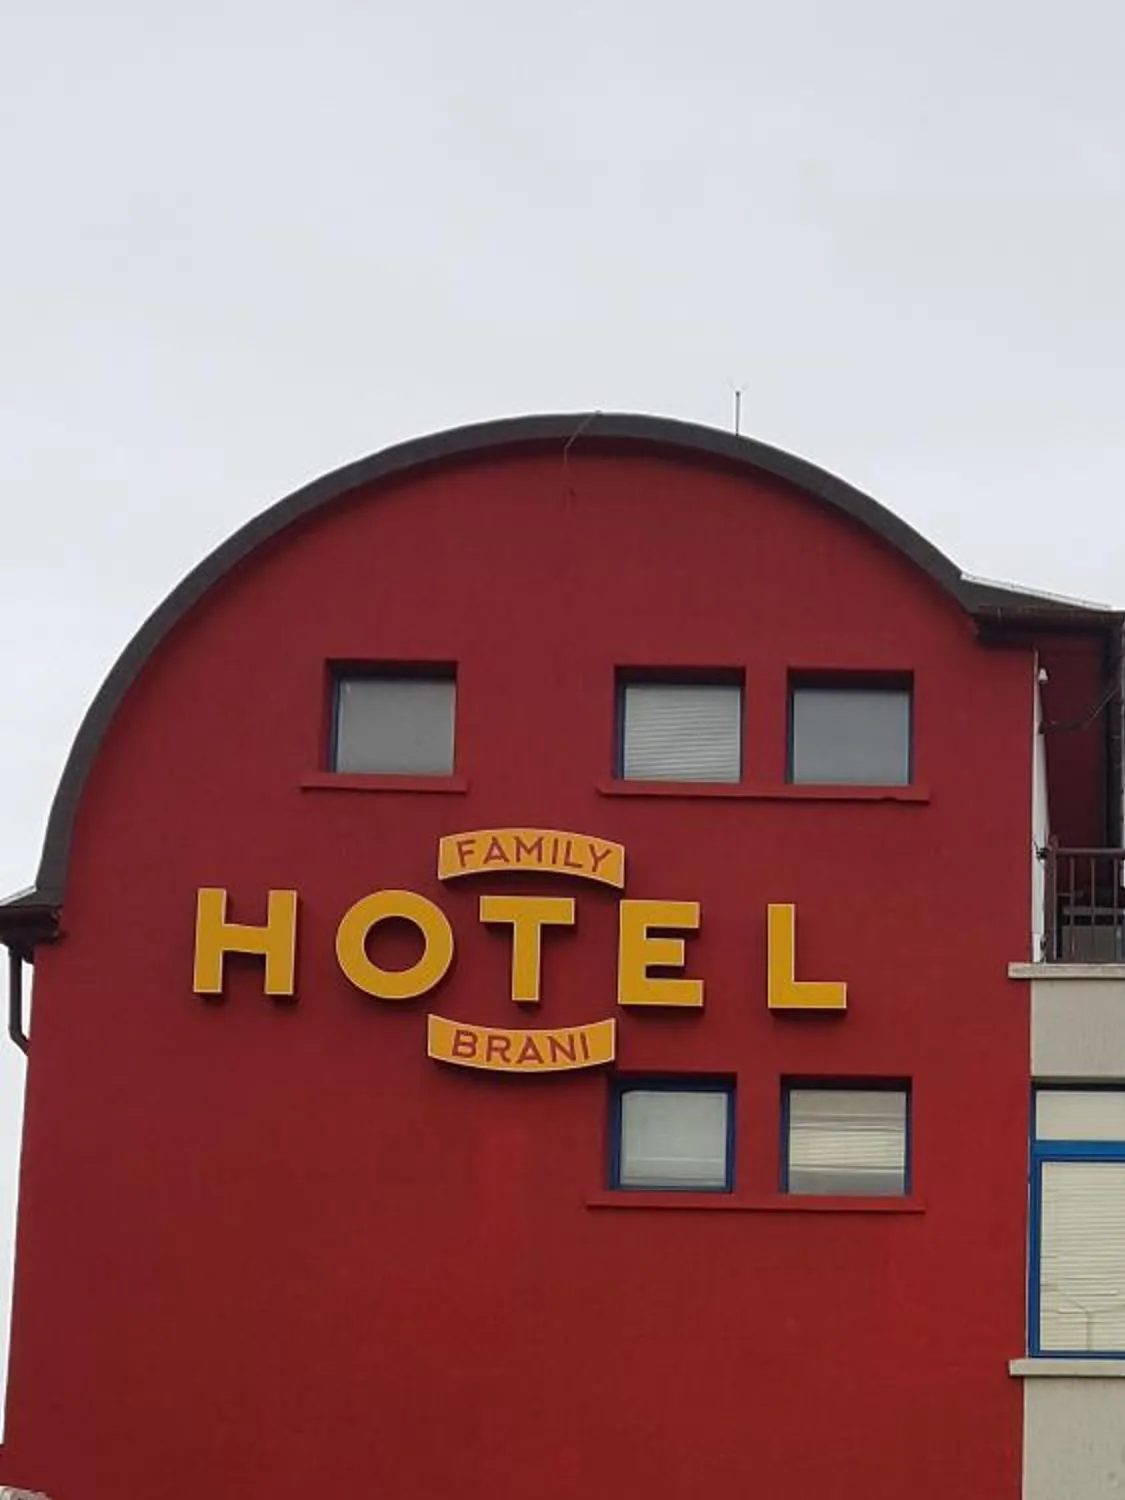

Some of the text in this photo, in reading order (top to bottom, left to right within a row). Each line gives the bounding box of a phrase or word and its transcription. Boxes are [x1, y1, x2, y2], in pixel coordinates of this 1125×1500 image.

[456, 835, 612, 874] FAMILY
[193, 887, 848, 1009] HOTEL
[451, 1029, 590, 1065] BRANI
